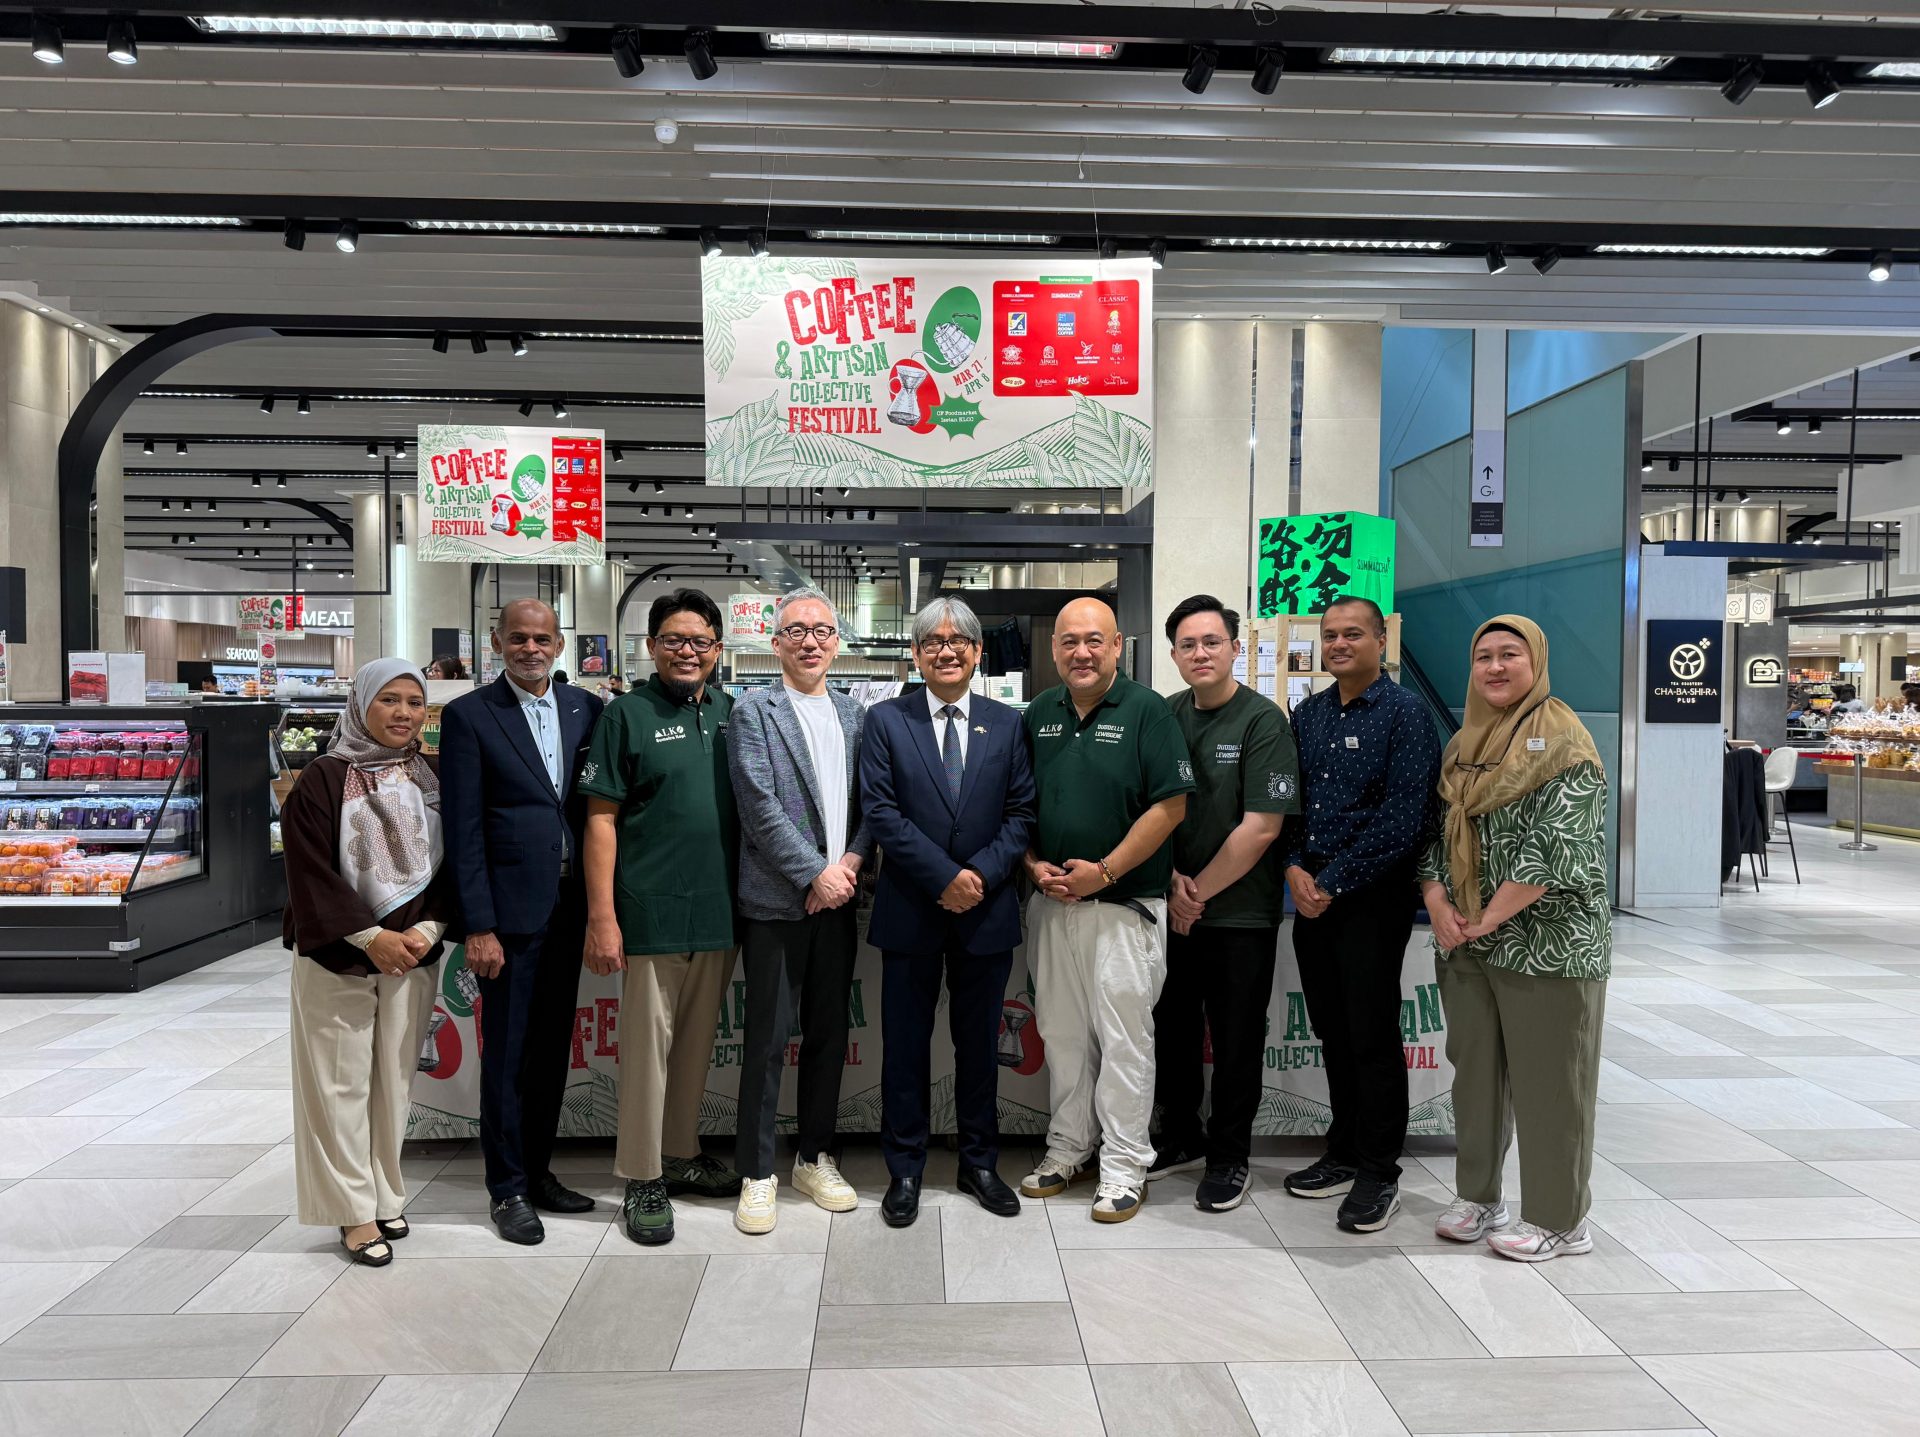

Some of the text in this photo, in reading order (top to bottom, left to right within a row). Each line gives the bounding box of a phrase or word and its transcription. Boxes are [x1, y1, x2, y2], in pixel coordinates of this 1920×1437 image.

[1098, 295, 1129, 303] CLASSIC
[784, 277, 917, 346] COFFEE
[774, 340, 890, 380] & ARTISAN
[952, 368, 974, 386] MAR
[964, 378, 984, 395] APR
[981, 372, 990, 383] 8
[789, 381, 873, 405] COLLECTIVE
[787, 407, 882, 434] FESTIVAL
[430, 448, 508, 486] COFFEE
[425, 483, 492, 506] & ARTISAN
[433, 505, 482, 519] COLLECTIVE
[431, 519, 487, 536] FESTIVAL
[241, 597, 269, 612] COFFEE
[733, 602, 761, 616] COFFEE
[301, 611, 352, 626] MEAT
[226, 647, 258, 661] SEAFOOD
[1654, 687, 1718, 696] CHA-BA-SHI-RA
